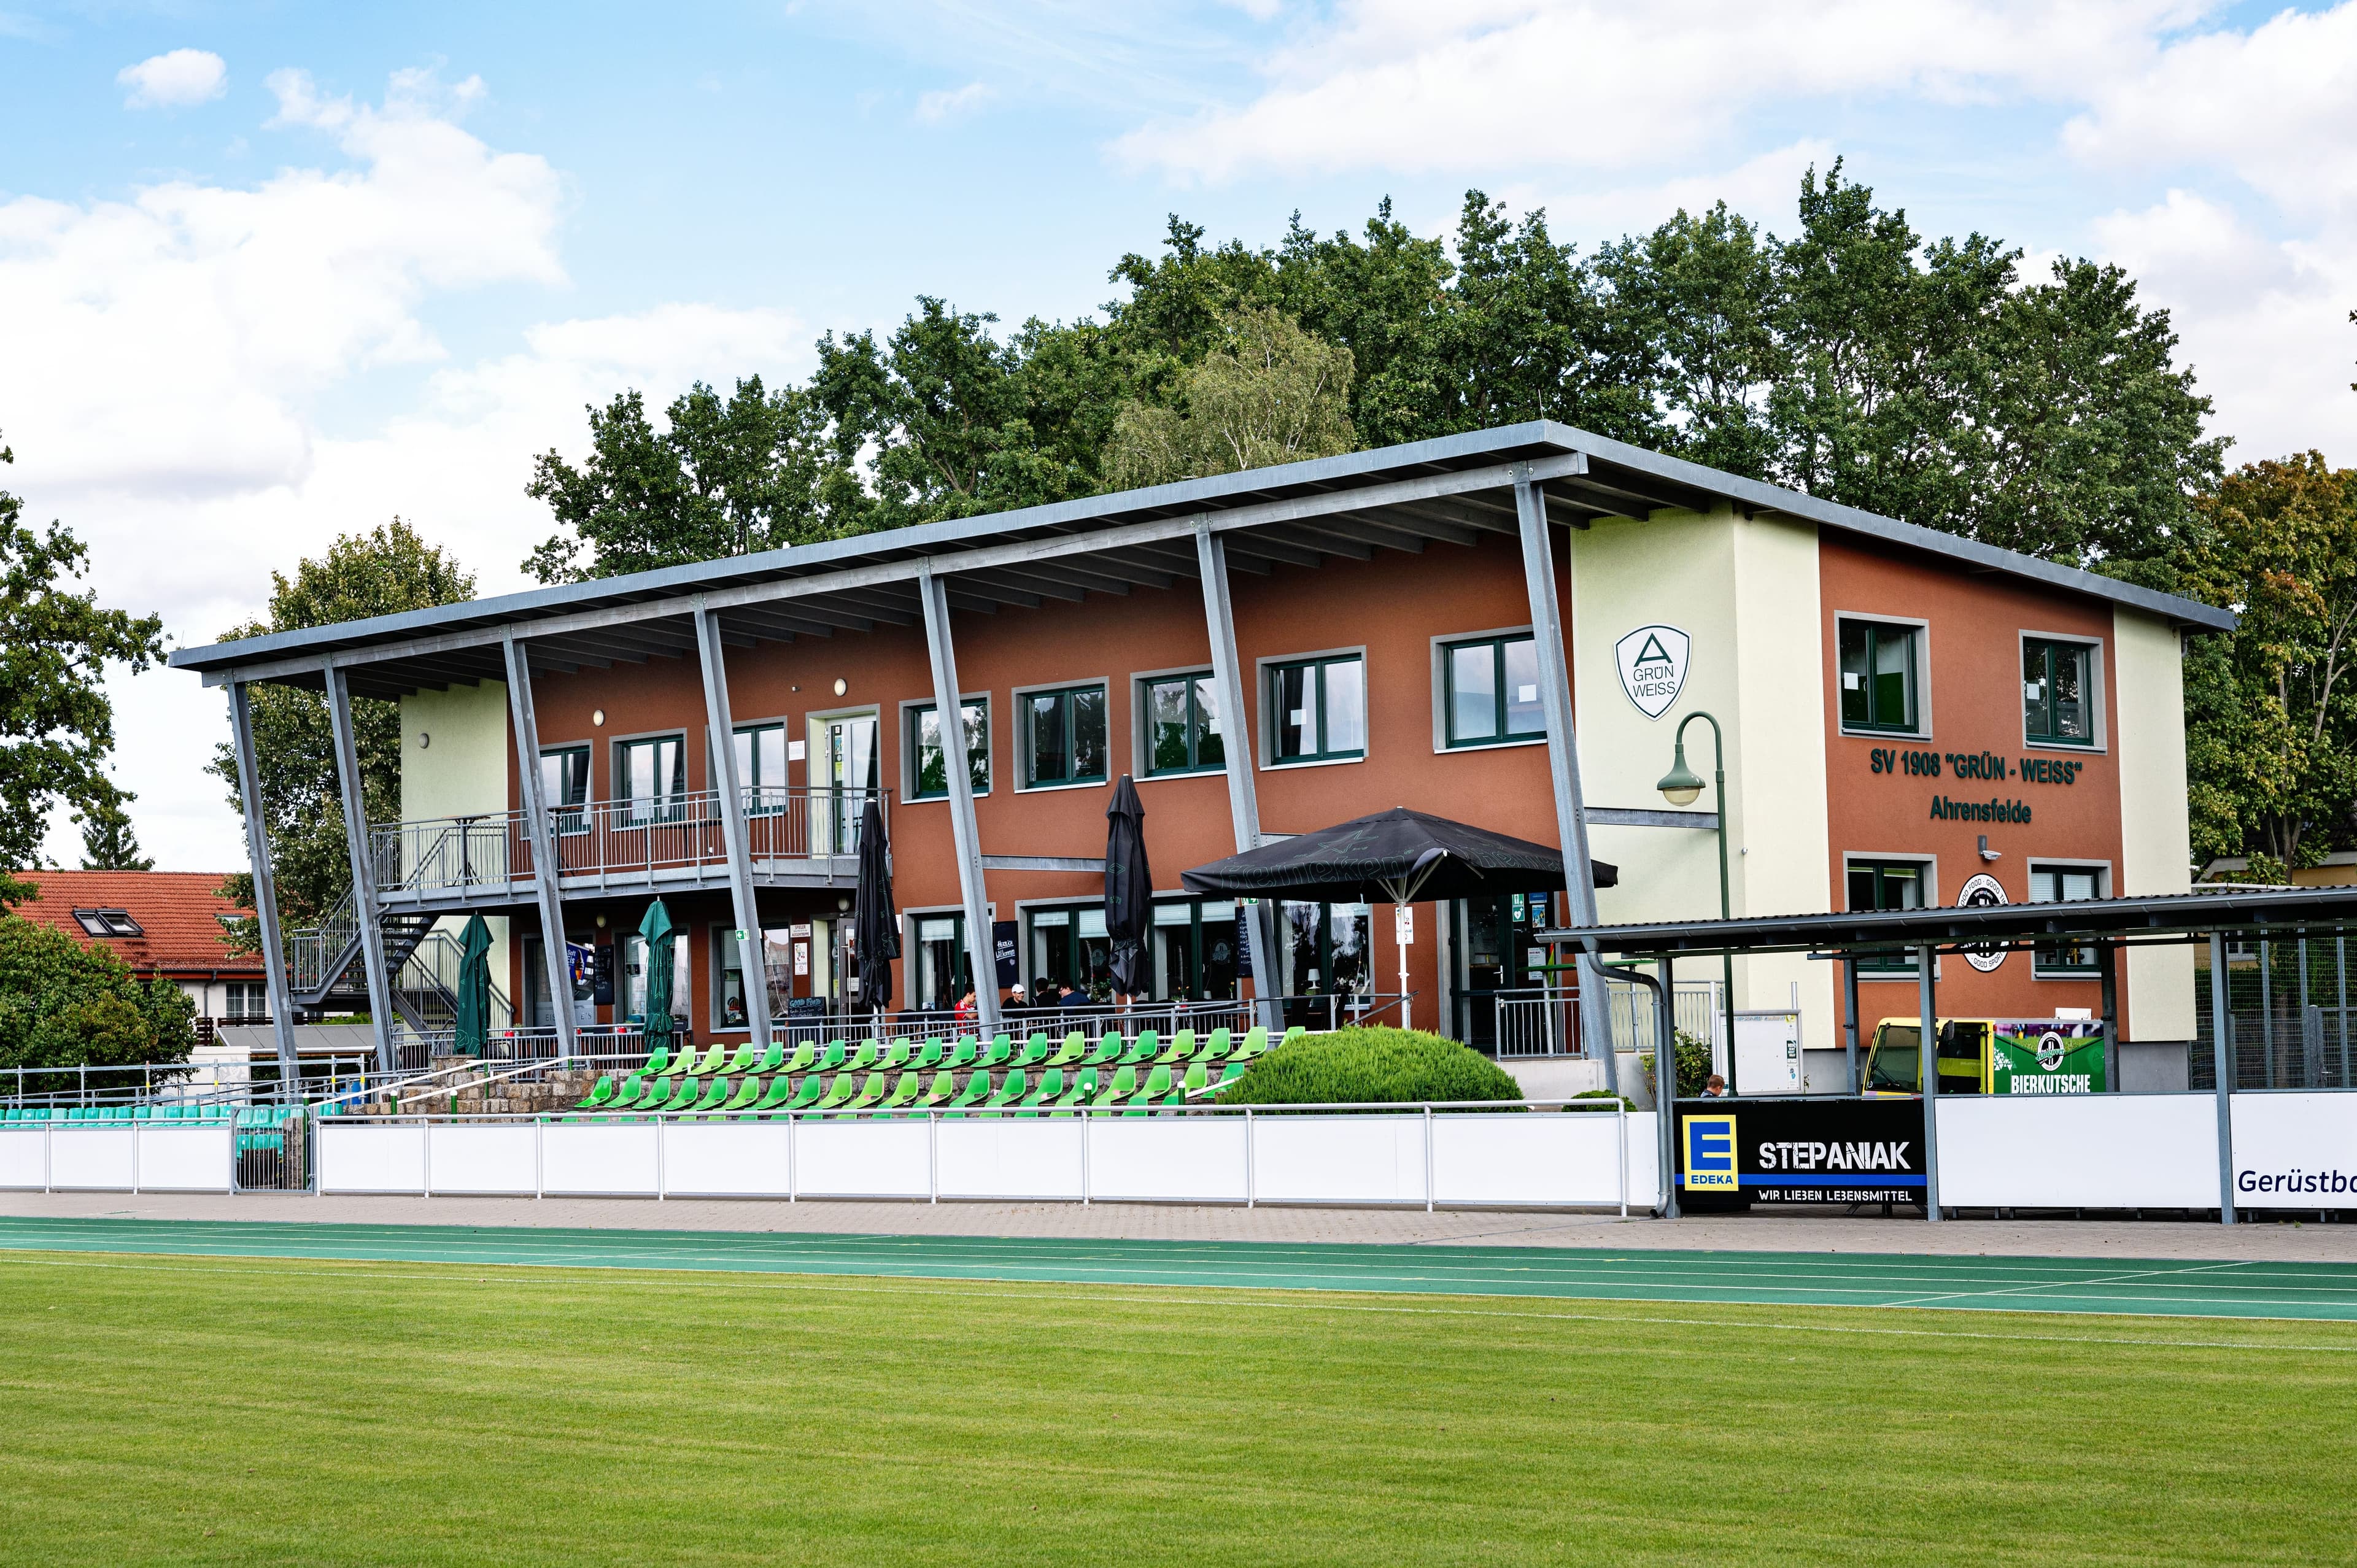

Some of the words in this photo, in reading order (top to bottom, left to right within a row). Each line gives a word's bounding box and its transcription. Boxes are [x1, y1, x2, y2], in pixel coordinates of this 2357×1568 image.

[1633, 632, 1673, 667] A
[1633, 665, 1674, 682] GRÜN
[1633, 681, 1676, 698] WEISS
[1870, 748, 1896, 774] SV
[1900, 751, 1941, 776] 1908
[1945, 751, 2006, 781] "GRÜN
[2020, 758, 2083, 784] WEISS"
[1930, 795, 2032, 824] Ahrensfelde
[1968, 878, 1982, 891] FOOD
[1986, 879, 2000, 894] GOOD
[1973, 957, 1987, 968] GOOD
[2011, 1074, 2091, 1094] BIERKUTSCHE
[1759, 1141, 1911, 1170] STEPANIAK
[1691, 1175, 1733, 1184] EDEKA
[1759, 1189, 1781, 1201] WIR
[1784, 1190, 1822, 1201] LIEBEN
[1827, 1190, 1913, 1202] LEBENSMITTEL
